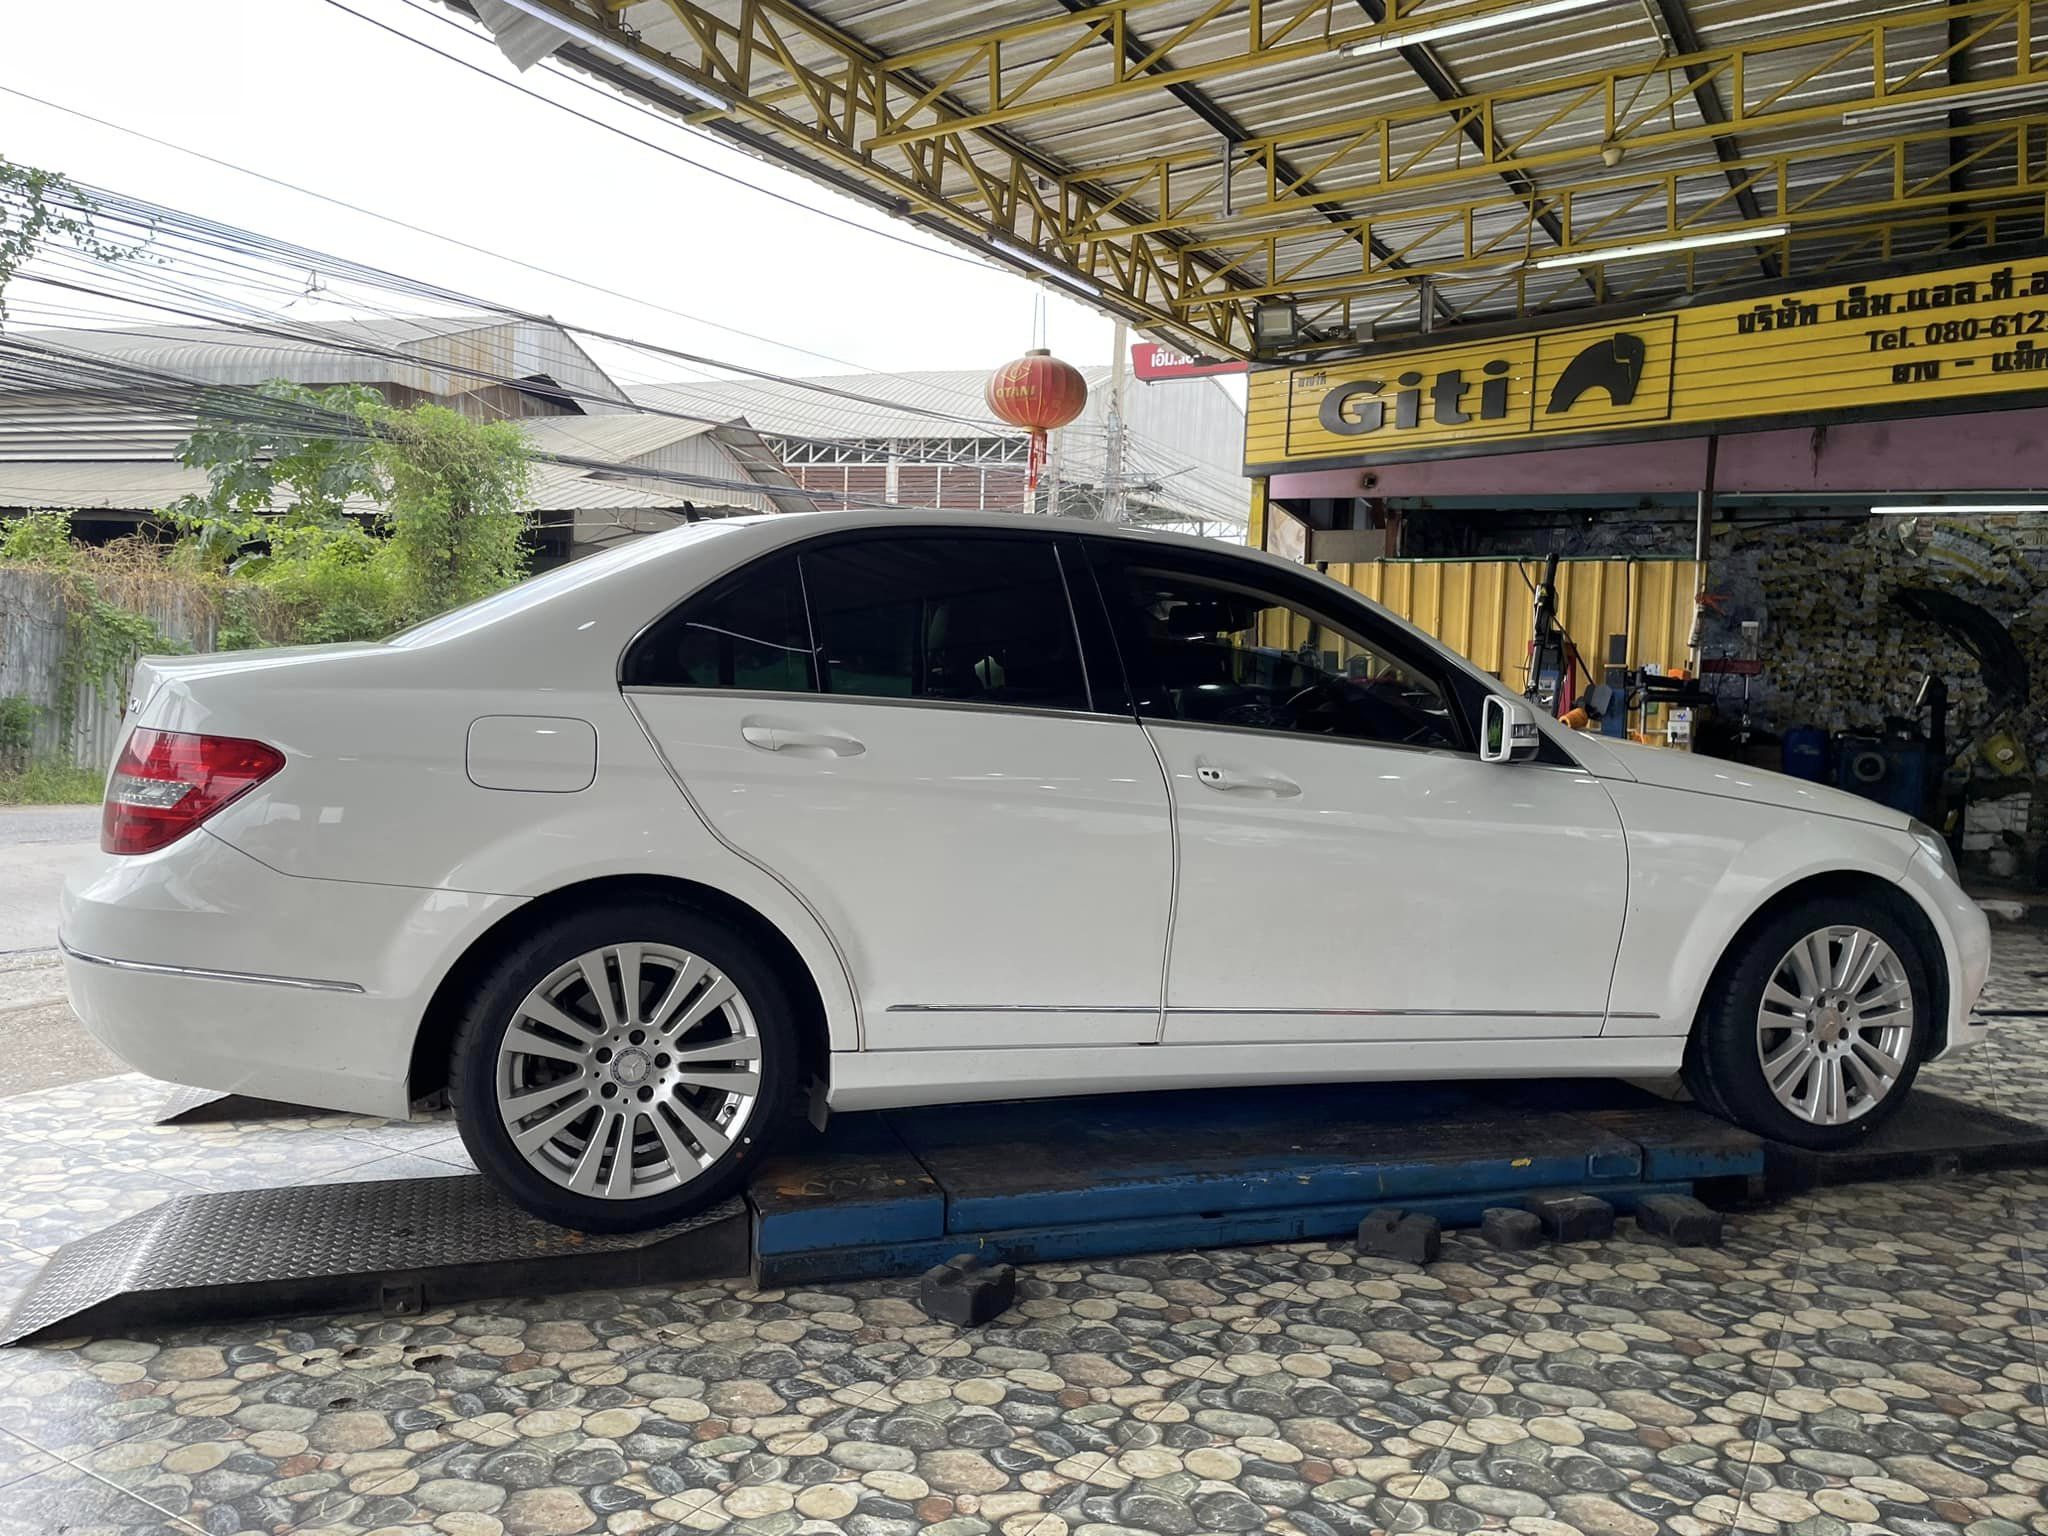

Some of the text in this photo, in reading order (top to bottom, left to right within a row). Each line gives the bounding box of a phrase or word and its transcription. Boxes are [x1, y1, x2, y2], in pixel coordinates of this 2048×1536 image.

[1737, 298, 1818, 334] บริษัท
[1865, 309, 2048, 352] Tel. 080-612
[1891, 359, 1941, 384] ยาง
[996, 385, 1036, 399] OTANI
[1318, 359, 1511, 436] Giti
